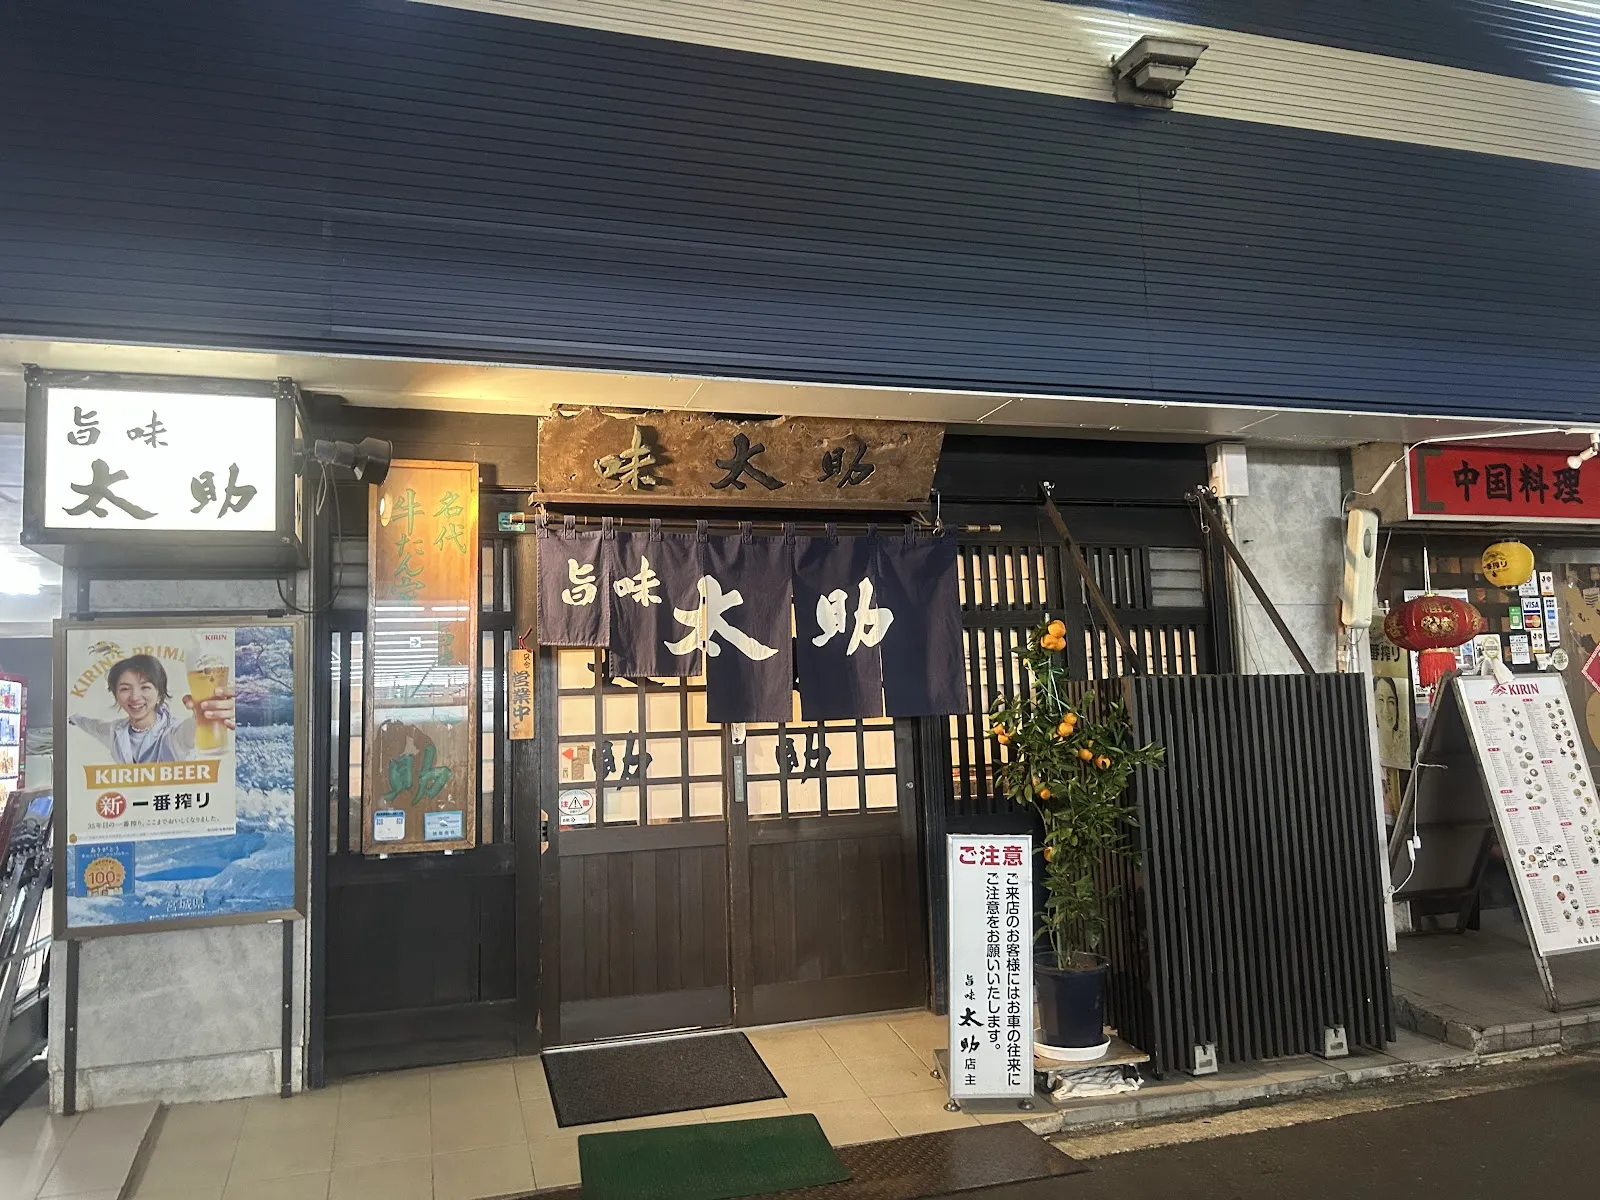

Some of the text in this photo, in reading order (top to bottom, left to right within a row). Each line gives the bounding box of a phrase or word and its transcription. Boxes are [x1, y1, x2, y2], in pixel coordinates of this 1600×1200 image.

[67, 406, 168, 448] 旨味
[592, 424, 876, 491] 味太助
[62, 458, 257, 520] 太助
[1453, 459, 1584, 504] 中国料理
[433, 491, 467, 554] 名代
[1525, 601, 1540, 609] VISA
[1508, 684, 1540, 695] KIRIN
[95, 765, 211, 785] KIRIN BEER
[99, 794, 124, 816] 新
[132, 793, 211, 811] 一番搾り
[959, 845, 1023, 866] ご注意
[986, 872, 1001, 1050] ご注意をお願いいたします。
[1006, 872, 1021, 1086] ご来店のお客様にはお車の往来に
